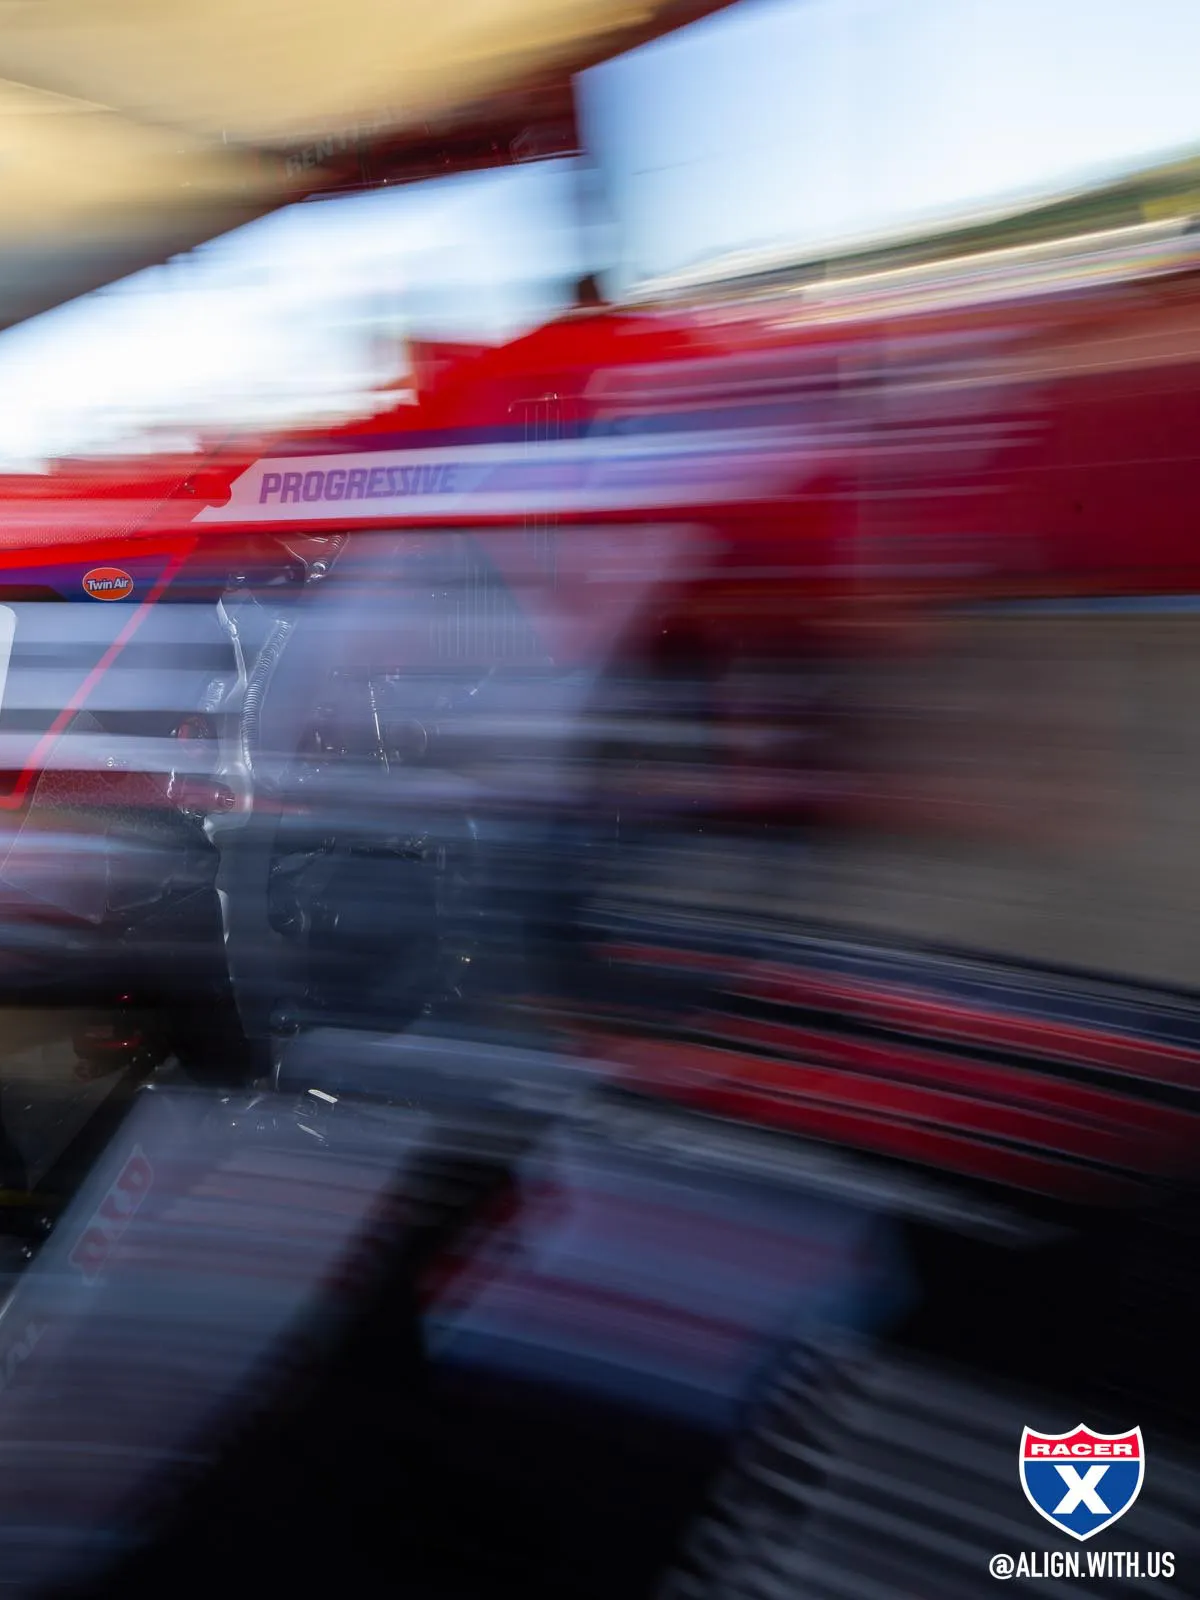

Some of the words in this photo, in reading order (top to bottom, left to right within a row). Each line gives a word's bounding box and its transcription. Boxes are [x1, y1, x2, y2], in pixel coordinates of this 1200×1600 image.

[259, 463, 459, 503] PROGRESSIVE
[87, 580, 113, 590] Twin
[114, 578, 129, 588] Air
